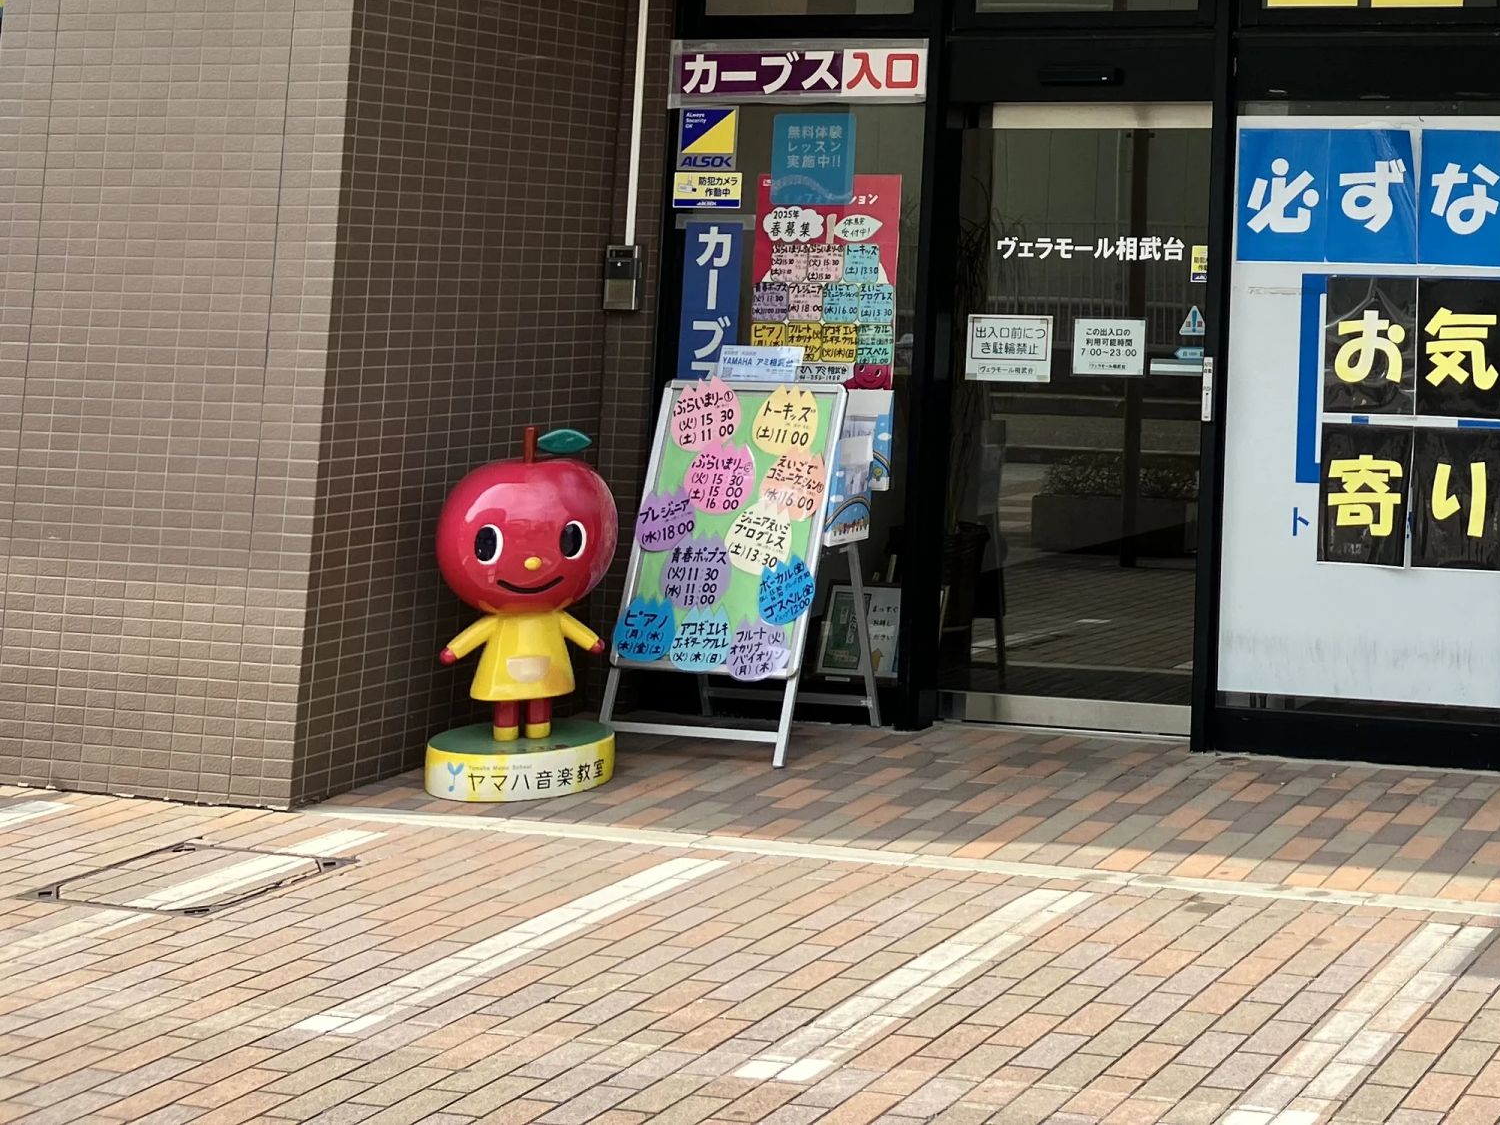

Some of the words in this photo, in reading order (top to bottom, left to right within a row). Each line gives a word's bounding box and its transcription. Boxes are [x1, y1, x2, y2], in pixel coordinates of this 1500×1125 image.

[787, 126, 842, 139] 無料体験
[788, 141, 841, 153] レッスン
[681, 156, 732, 168] ALSOK
[698, 177, 738, 187] 防犯カメラ
[705, 187, 731, 197] 作動中
[773, 209, 800, 220] 2025年
[846, 244, 879, 255] トーキッズ
[997, 237, 1185, 261] ヴェラモール相武台
[754, 325, 782, 337] ピアノ
[975, 326, 1046, 339] 出入口前につ
[1085, 328, 1131, 337] この出入口の
[1085, 337, 1133, 347] 利用可能時間
[980, 341, 1039, 356] き駐輪禁止
[722, 356, 752, 366] YAMAHA
[979, 364, 1034, 375] ヴェラモール相武台
[763, 401, 816, 422] トーキッズ
[671, 546, 727, 564] 青春ポップス
[624, 609, 668, 628] ピアノ
[467, 758, 605, 792] ヤマハ音楽教室
